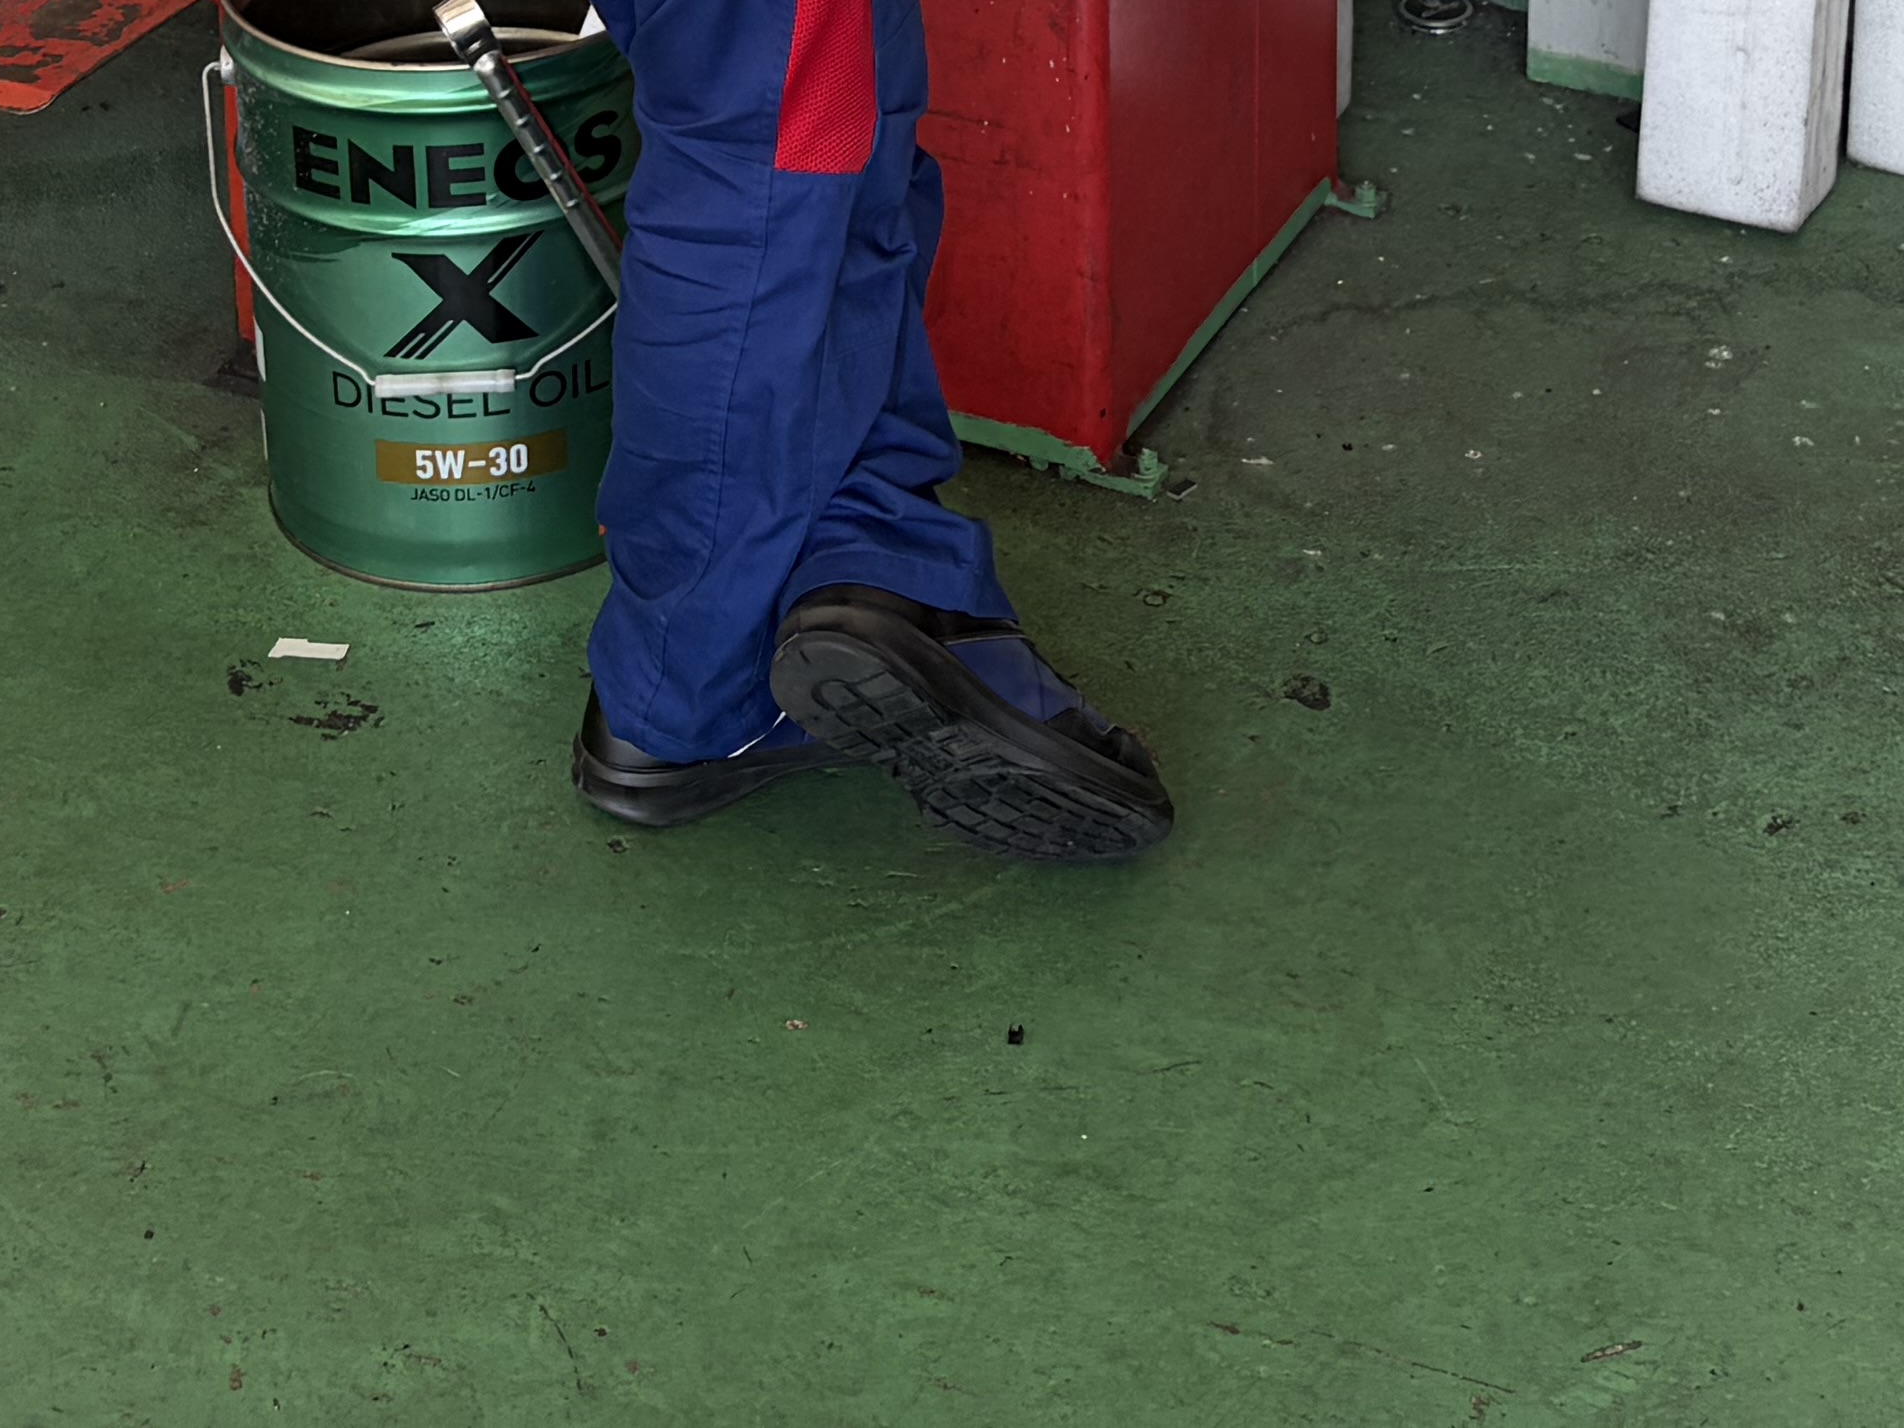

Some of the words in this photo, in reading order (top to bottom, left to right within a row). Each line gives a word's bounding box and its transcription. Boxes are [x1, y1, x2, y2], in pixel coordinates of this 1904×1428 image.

[291, 109, 622, 210] ENEOS
[382, 229, 546, 361] X
[527, 359, 611, 409] OIL
[414, 443, 529, 480] 5W-30
[411, 485, 451, 502] JASO
